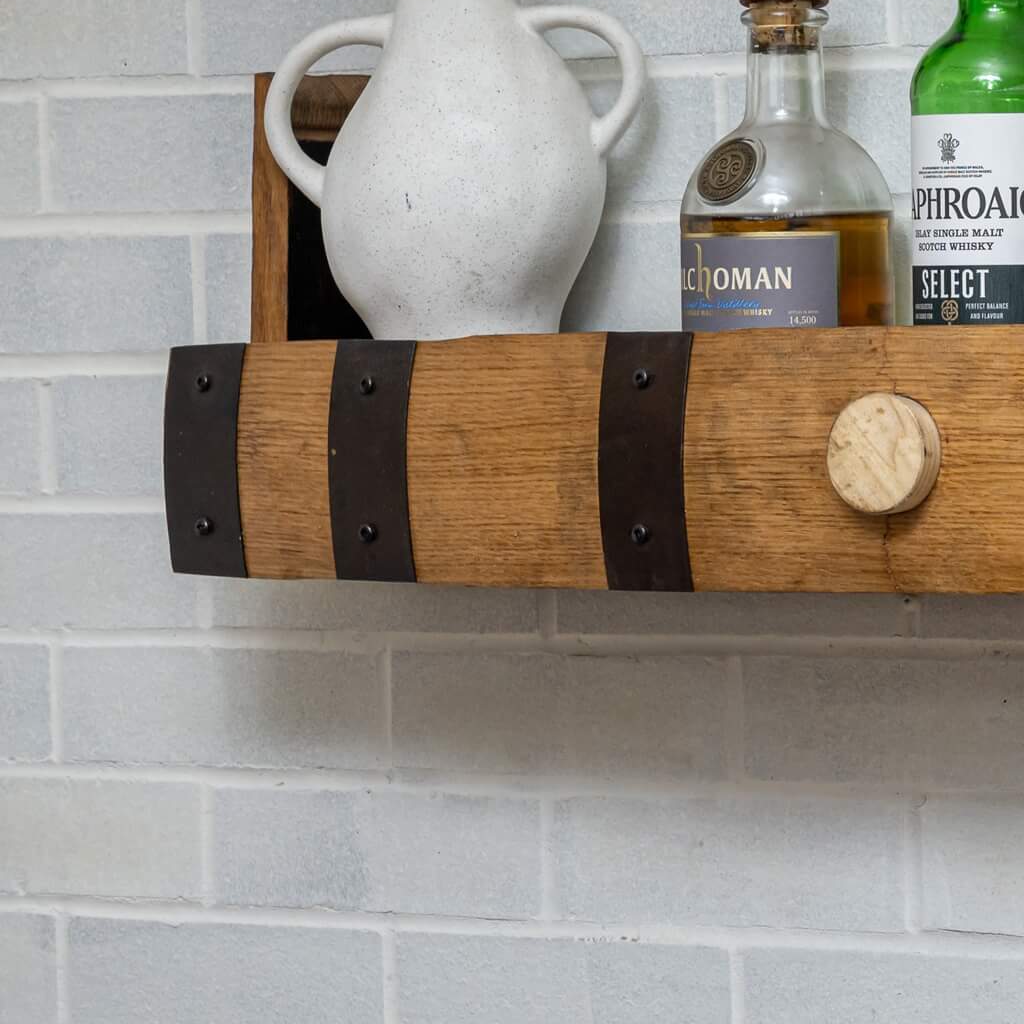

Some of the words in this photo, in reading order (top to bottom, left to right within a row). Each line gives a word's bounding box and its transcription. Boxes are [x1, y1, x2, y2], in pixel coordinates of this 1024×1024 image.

[933, 228, 969, 238] SINGLE
[972, 228, 1004, 237] MALT
[918, 242, 946, 252] SCOTCH
[949, 242, 994, 251] WHISKY
[922, 268, 990, 299] SELECT
[965, 302, 985, 310] PERFECT
[986, 302, 1009, 310] BALANCE
[970, 312, 980, 320] AND
[981, 312, 1004, 320] FLAVOUR
